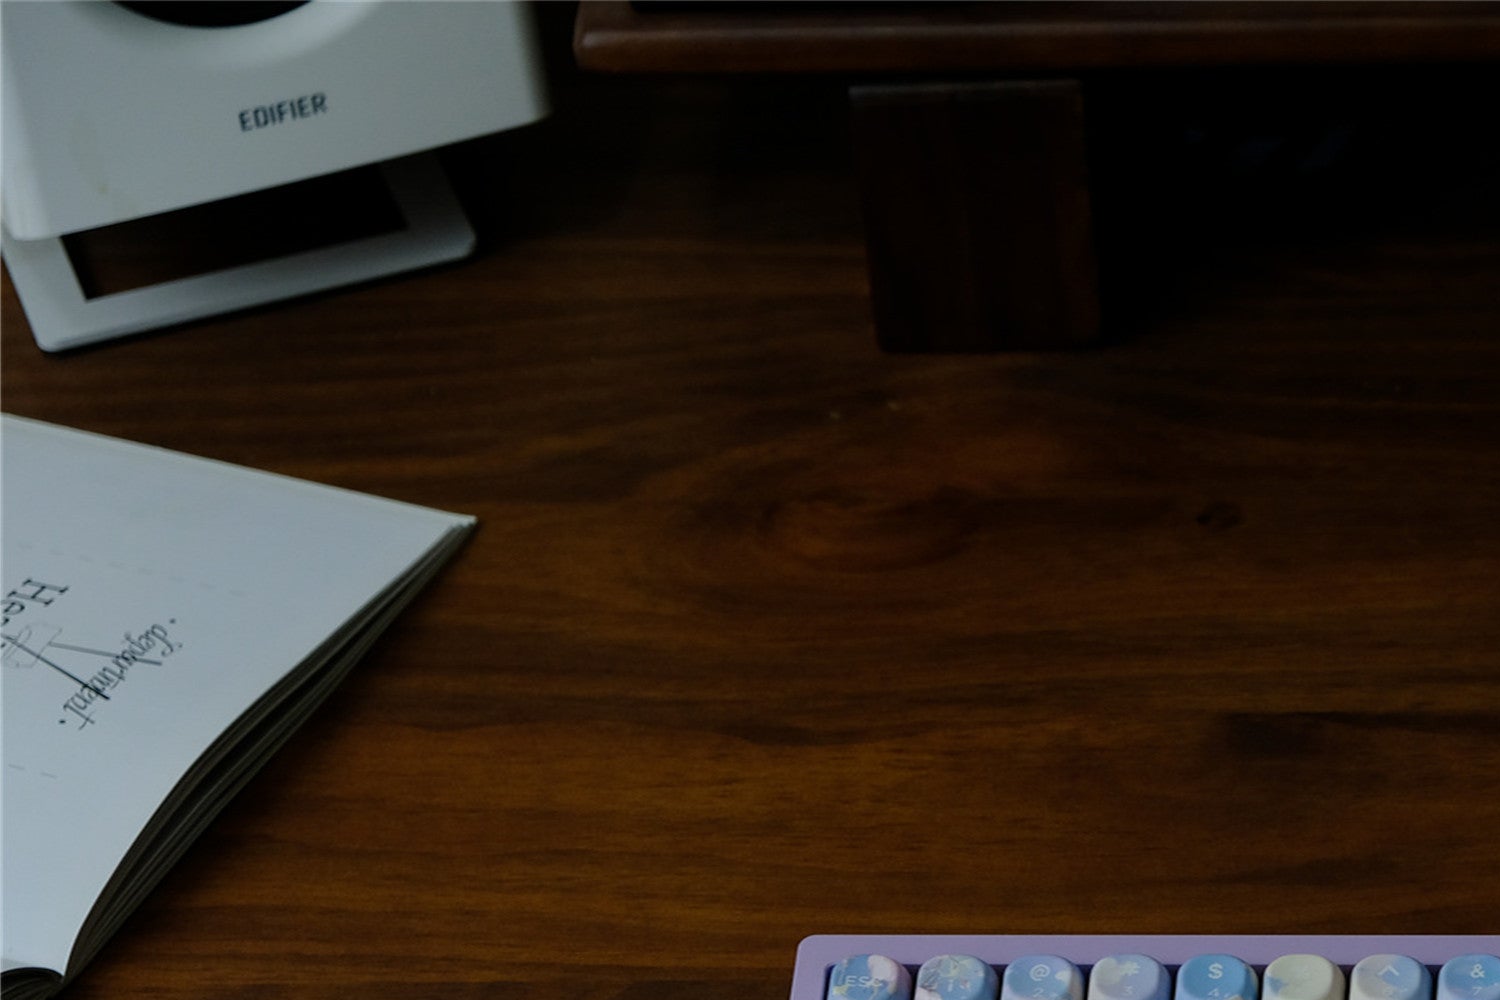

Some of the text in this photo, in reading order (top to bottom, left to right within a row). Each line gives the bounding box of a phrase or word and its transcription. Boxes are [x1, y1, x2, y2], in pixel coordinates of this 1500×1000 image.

[238, 92, 328, 132] EDIFIER
[1030, 963, 1051, 981] @
[1207, 962, 1223, 980] $
[1470, 963, 1486, 979] &
[846, 974, 885, 988] ESC
[1032, 986, 1044, 998] 2
[1471, 986, 1482, 996] 7
